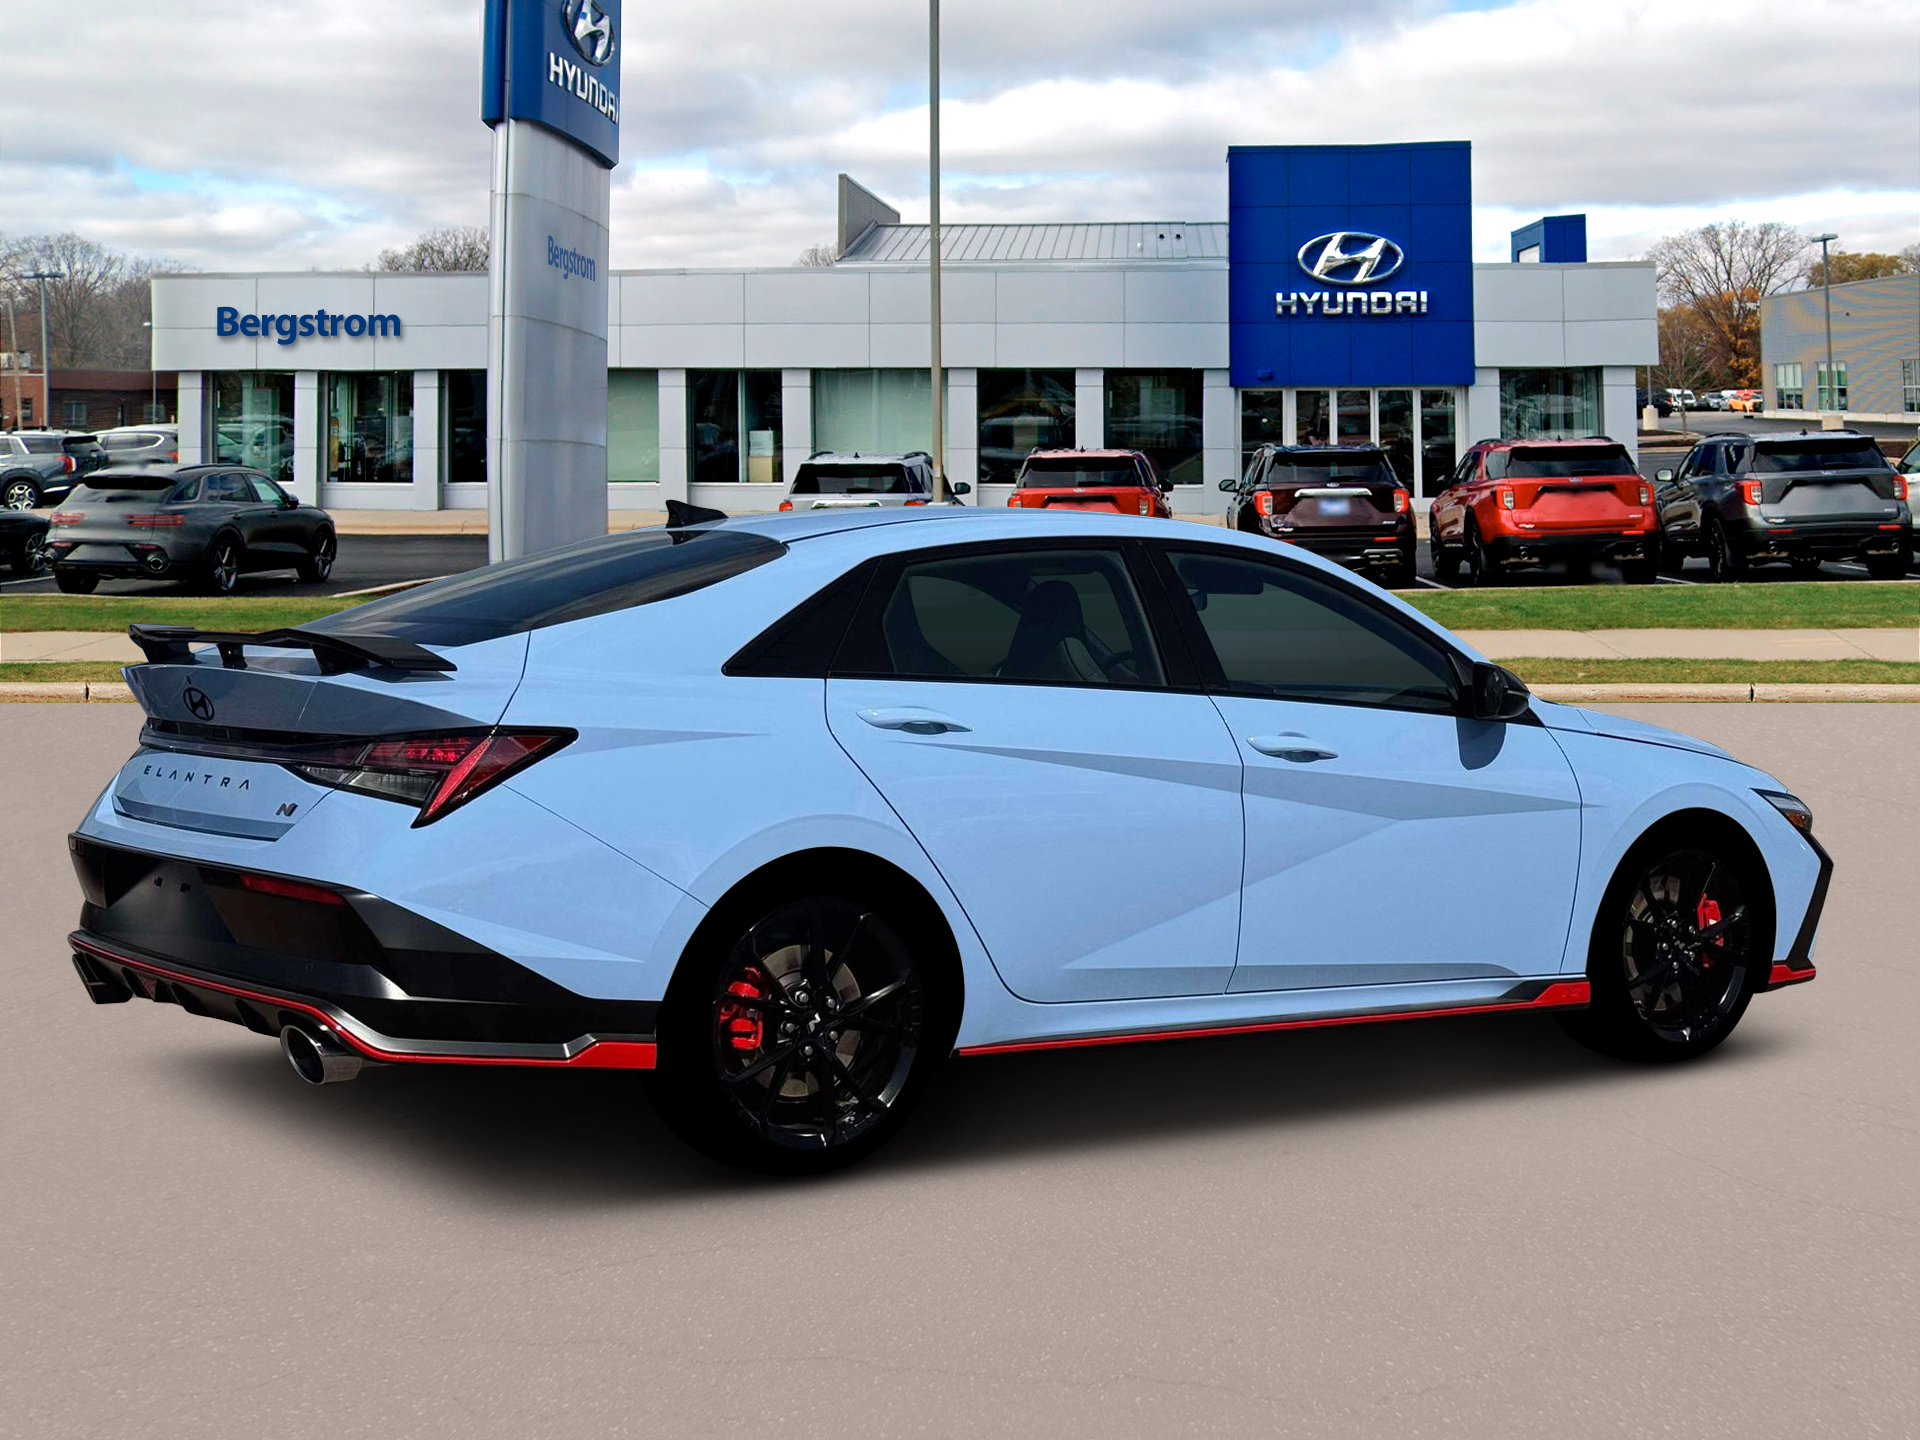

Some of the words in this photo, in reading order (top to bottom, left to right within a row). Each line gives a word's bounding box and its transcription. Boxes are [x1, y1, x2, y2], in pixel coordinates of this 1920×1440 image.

[549, 52, 619, 125] HYUNDAI
[547, 235, 596, 282] Bergstrom
[1275, 291, 1428, 315] HYUNDAI
[216, 306, 402, 346] Bergstrom
[143, 765, 250, 790] ELANTRA
